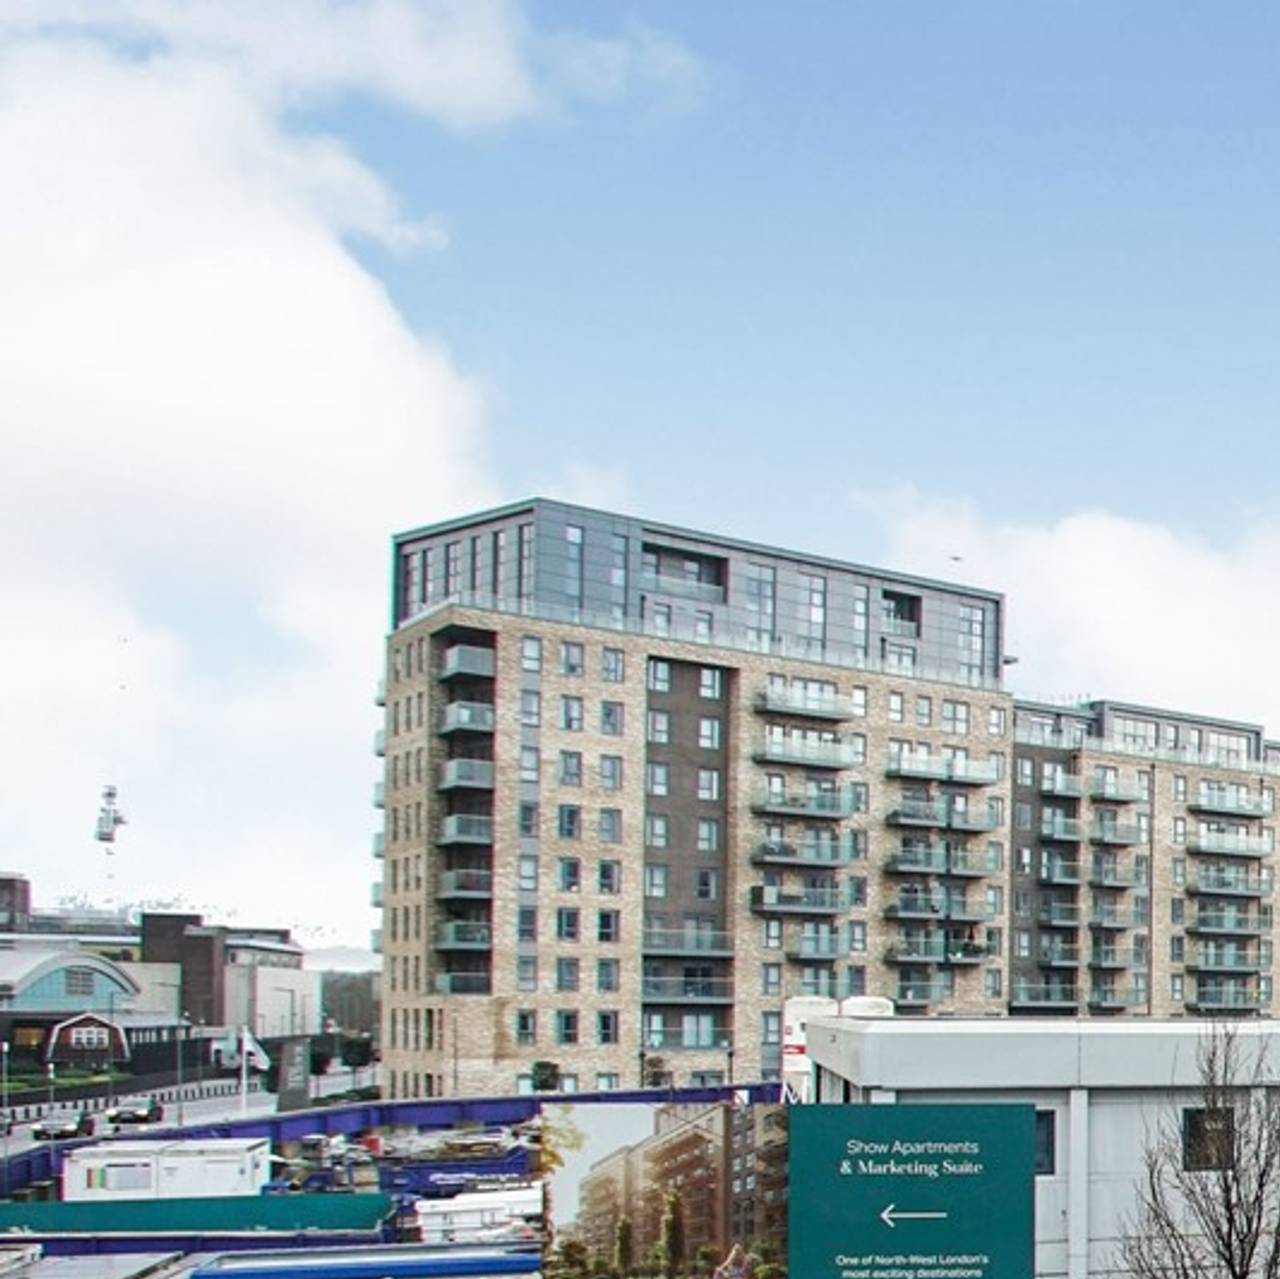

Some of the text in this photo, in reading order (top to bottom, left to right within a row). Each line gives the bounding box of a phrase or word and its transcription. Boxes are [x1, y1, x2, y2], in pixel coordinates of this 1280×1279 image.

[846, 1139, 980, 1155] Show Apartments
[840, 1159, 984, 1177] & Marketing Suite
[835, 1255, 859, 1266] One
[861, 1255, 873, 1265] of
[841, 1269, 870, 1279] most
[917, 1268, 983, 1279] destinations
